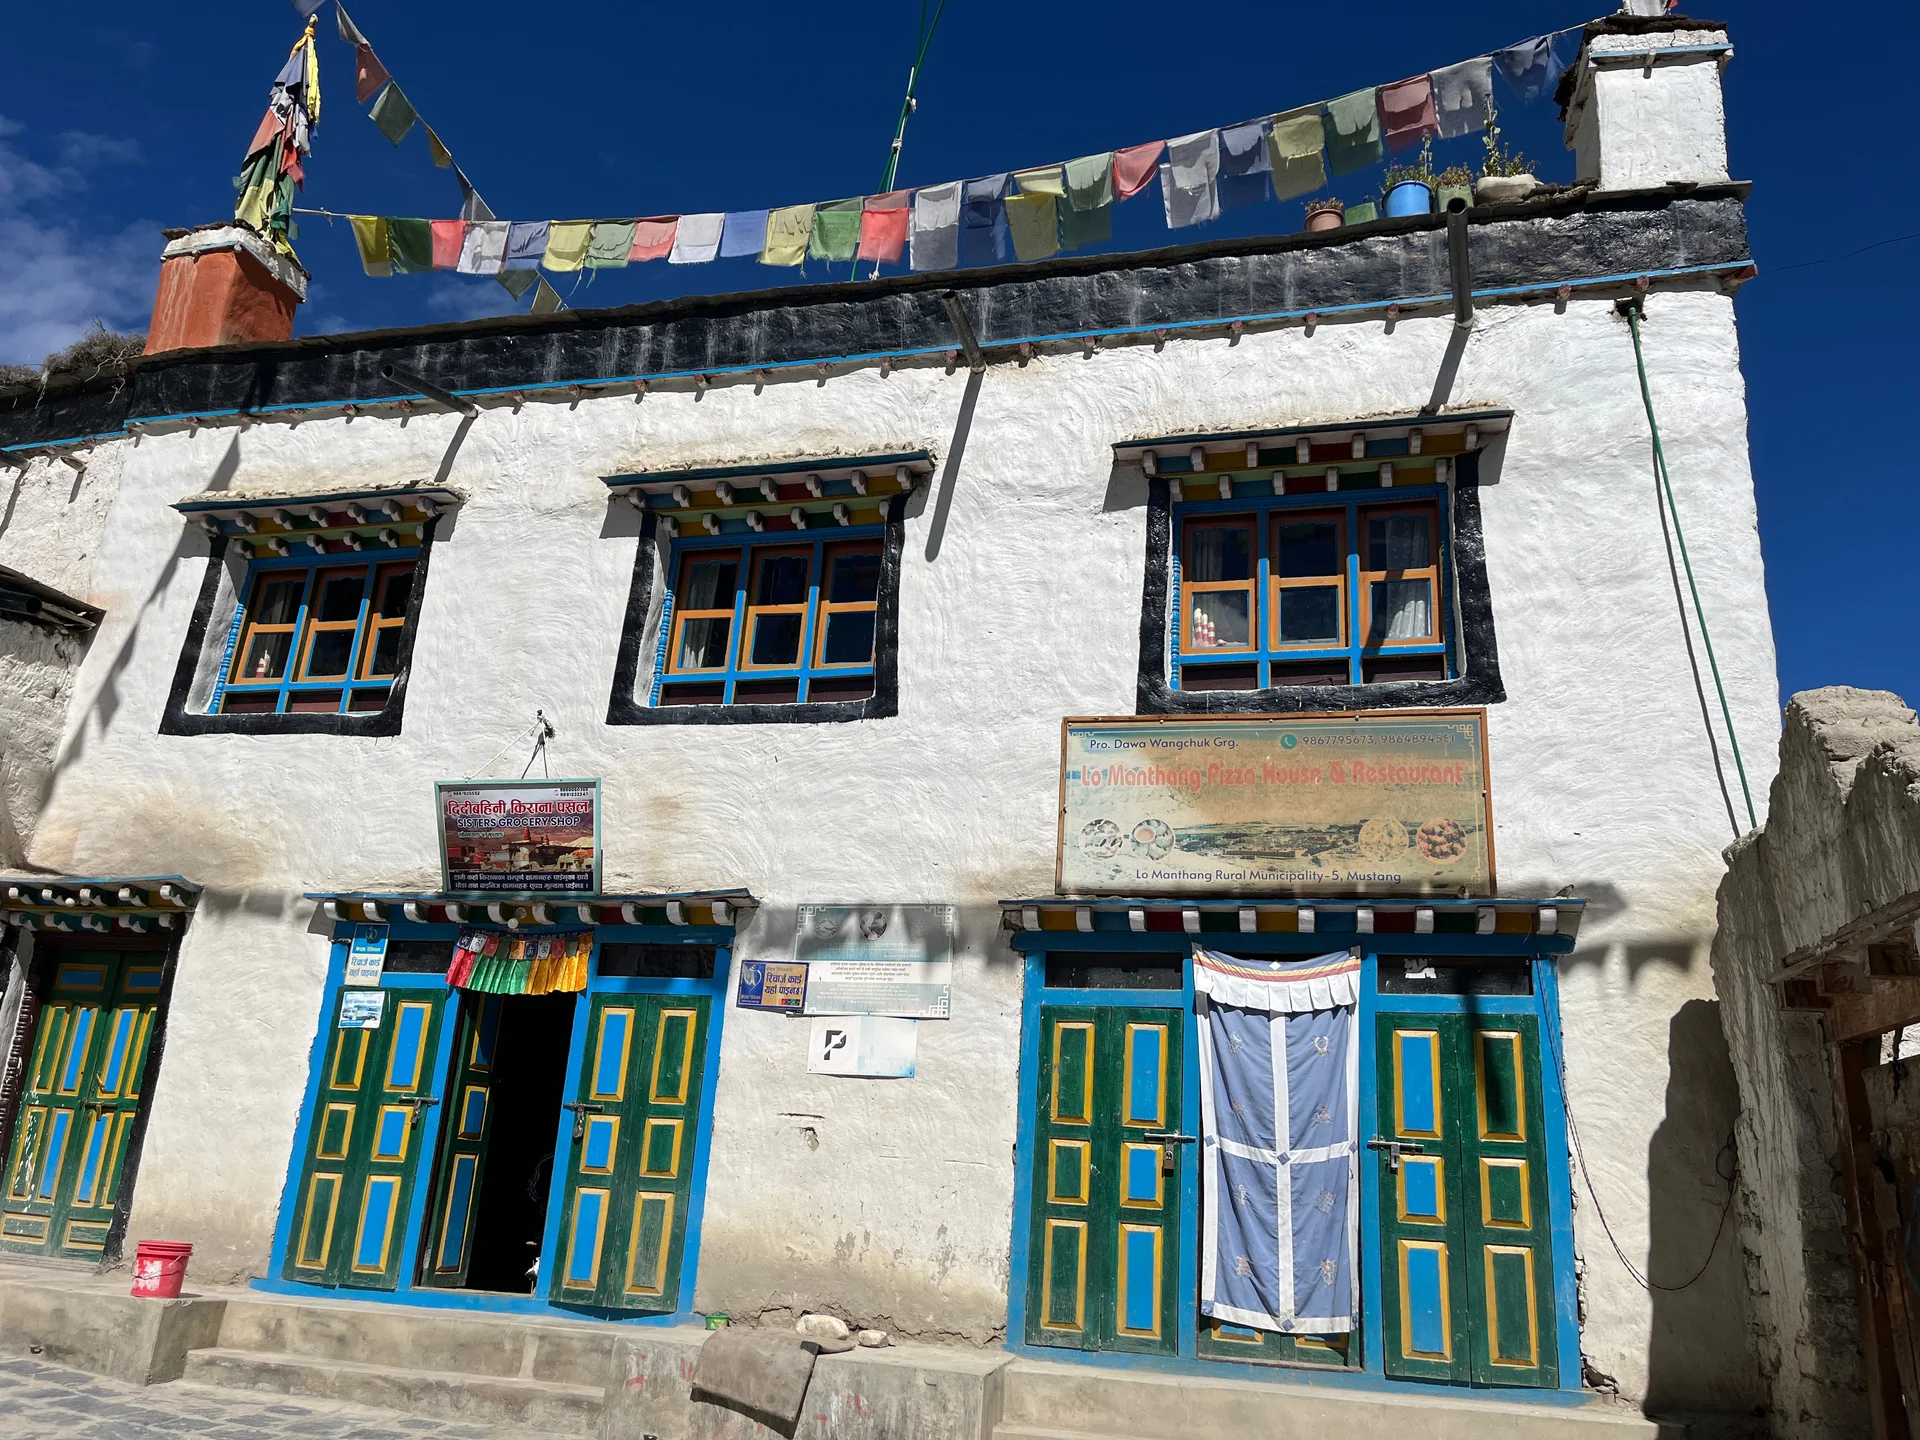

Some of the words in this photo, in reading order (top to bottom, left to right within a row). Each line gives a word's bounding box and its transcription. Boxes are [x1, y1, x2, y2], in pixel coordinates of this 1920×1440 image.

[1090, 739, 1111, 750] Pro.
[1114, 739, 1146, 749] Dawa
[1149, 737, 1210, 751] Wangchuk
[1213, 736, 1239, 750] Grg.
[1302, 734, 1377, 746] 9867795673,
[1081, 764, 1102, 787] Lo
[1107, 763, 1201, 792] Manthang
[1207, 762, 1256, 785] Pizza
[1262, 760, 1322, 785] House
[1329, 760, 1346, 784] &
[1352, 760, 1464, 784] Restaurant
[447, 799, 507, 816] दिदीबहिनी
[511, 798, 553, 814] किराना
[557, 800, 589, 814] पसल
[457, 818, 497, 828] SISTERS
[498, 817, 549, 827] GROCERY
[550, 816, 580, 827] SHOP
[1135, 869, 1149, 879] Lo
[1151, 869, 1213, 883] Manthang
[1215, 869, 1246, 880] Rural
[1249, 869, 1343, 883] Municipality-5,
[1346, 870, 1402, 884] Mustang
[351, 956, 368, 966] रिचार्ज
[369, 957, 381, 967] कार्ड
[766, 971, 786, 983] रिचार्ज
[787, 973, 803, 984] कार्ड
[764, 984, 777, 995] यहाँ
